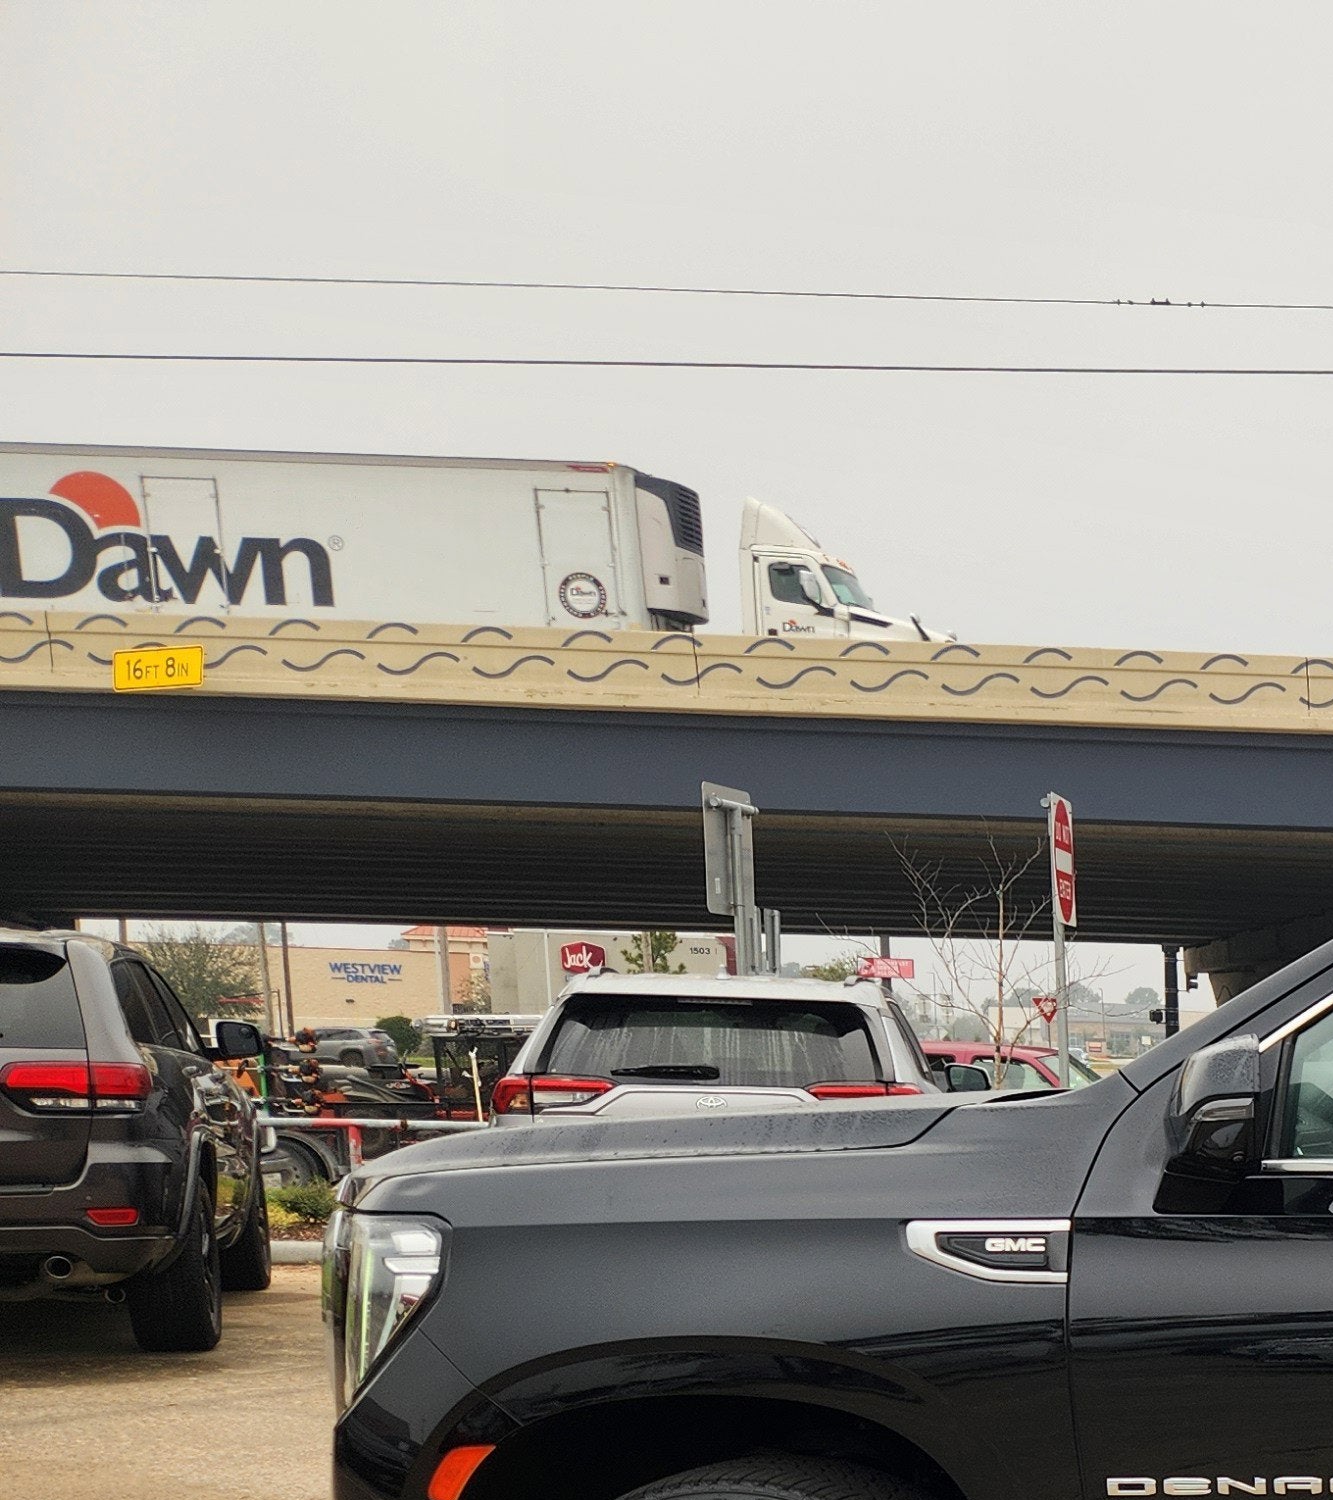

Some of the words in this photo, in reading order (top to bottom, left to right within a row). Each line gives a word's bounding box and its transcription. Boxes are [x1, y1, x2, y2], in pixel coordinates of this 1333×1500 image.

[0, 497, 335, 607] Dawn
[782, 621, 816, 634] Dawn
[563, 945, 593, 969] Jack
[690, 947, 711, 955] 1503
[329, 962, 402, 976] WESTVIEW
[346, 974, 387, 984] DENTAL
[985, 1237, 1046, 1252] GMC
